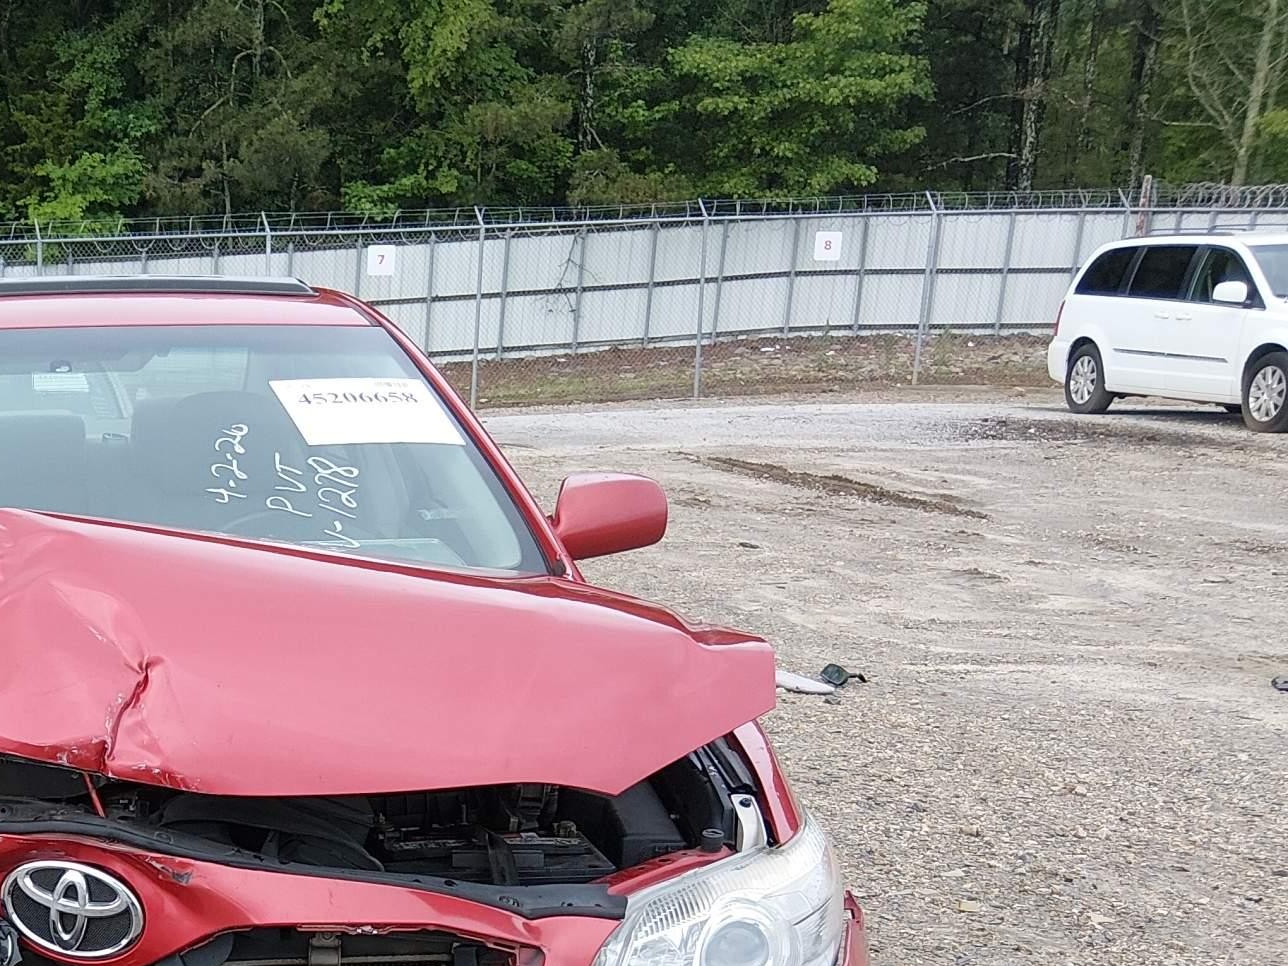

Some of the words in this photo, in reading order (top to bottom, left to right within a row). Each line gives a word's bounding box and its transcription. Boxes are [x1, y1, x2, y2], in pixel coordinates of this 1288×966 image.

[824, 240, 832, 250] 8
[377, 254, 385, 265] 7
[298, 392, 418, 405] 45206658
